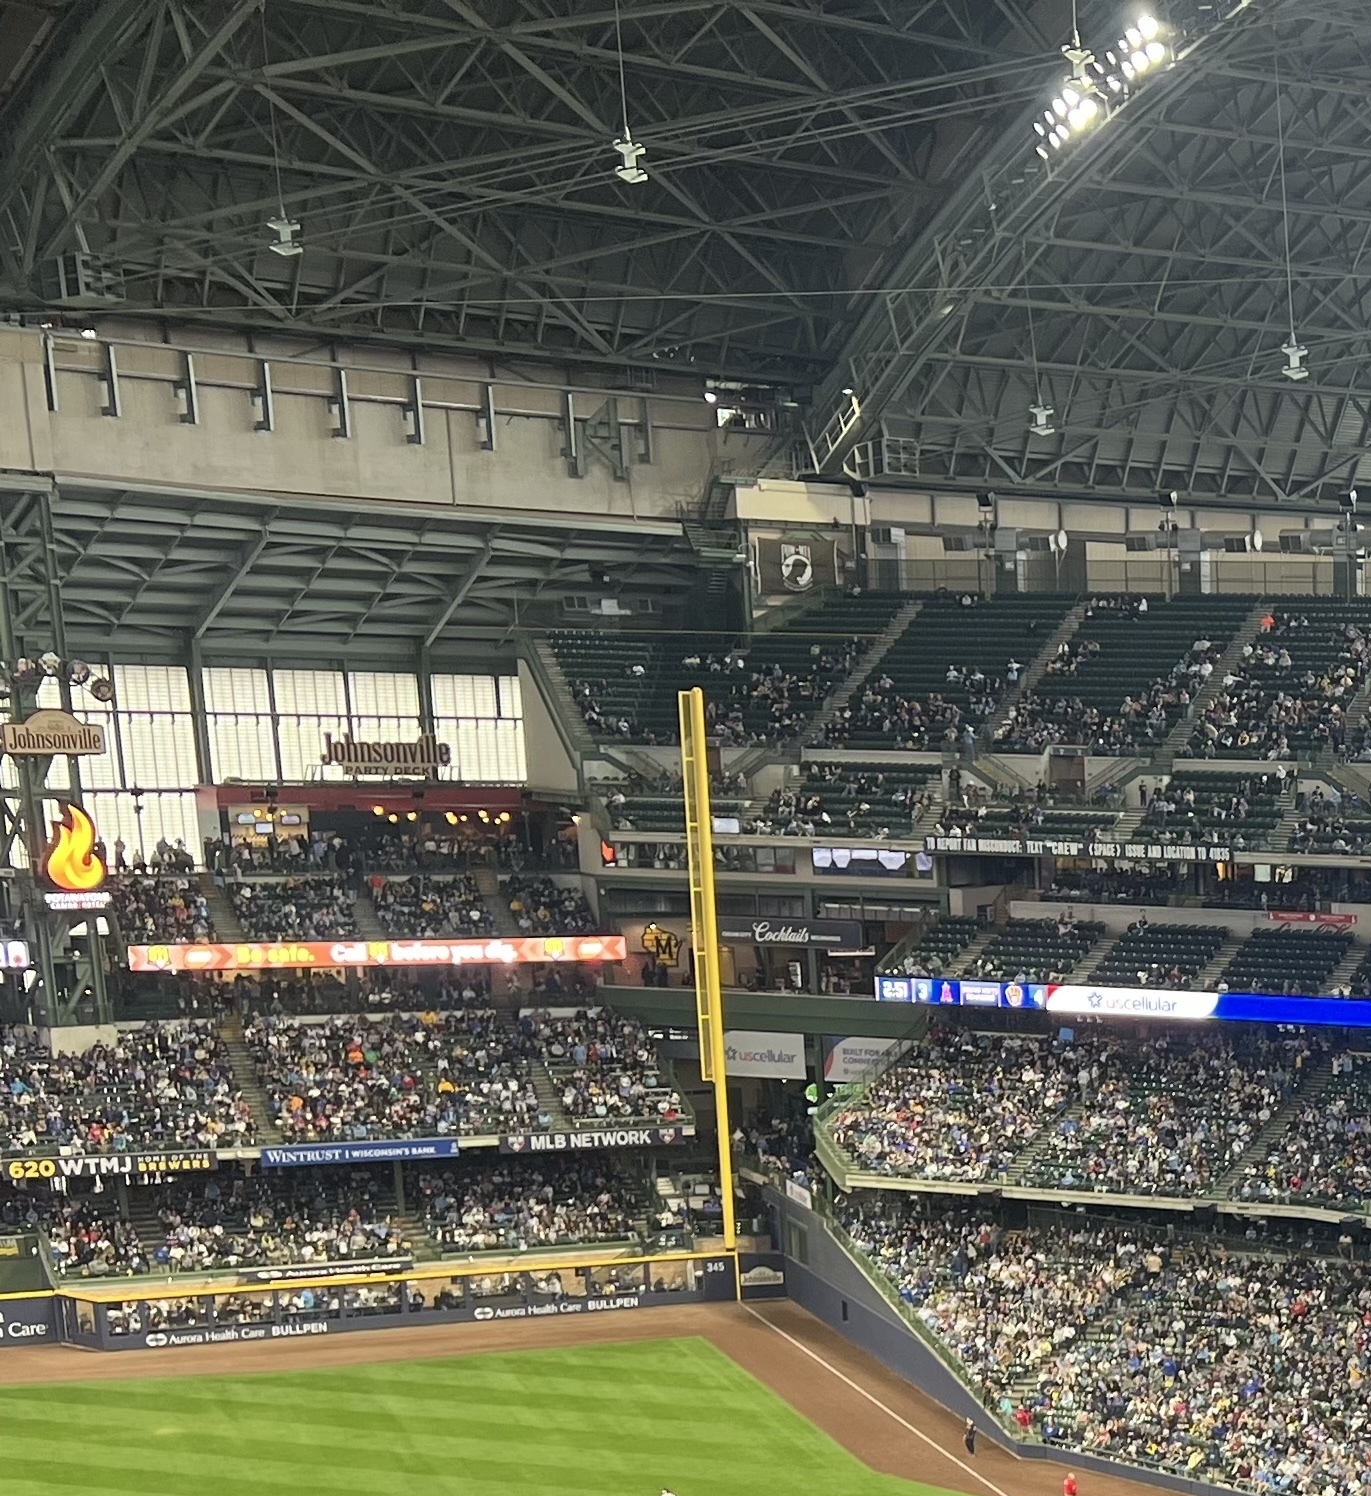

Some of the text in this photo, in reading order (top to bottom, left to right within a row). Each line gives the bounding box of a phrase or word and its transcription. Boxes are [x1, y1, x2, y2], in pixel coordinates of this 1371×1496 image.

[9, 726, 101, 750] Johnsonville
[320, 731, 452, 766] Johnsonville
[344, 765, 430, 776] PARTY DECK
[926, 836, 936, 849] TO
[937, 837, 961, 850] REPORT
[963, 838, 977, 851] FAN
[1026, 840, 1043, 854] TEXT
[1124, 844, 1146, 858] ISSUE
[1147, 845, 1161, 859] AND
[1163, 845, 1196, 860] LOCATION
[1197, 847, 1207, 860] TO
[752, 921, 810, 943] Cocktails
[237, 943, 368, 963] Be safe. Call
[391, 941, 450, 961] before
[450, 944, 484, 965] you
[917, 983, 928, 999] 3
[1106, 997, 1179, 1012] uscellular
[739, 1049, 797, 1064] uscellular
[530, 1129, 652, 1150] MLB NETWORK
[411, 1146, 436, 1156] BANK
[9, 1156, 133, 1179] 620 WTMJ
[137, 1159, 211, 1172] BREWERS
[706, 1261, 725, 1273] 345
[495, 1297, 639, 1318] Aurora Health Care BULLPEN
[8, 1321, 46, 1338] Care
[168, 1321, 328, 1345] Aurora Health Care BULLPEN
